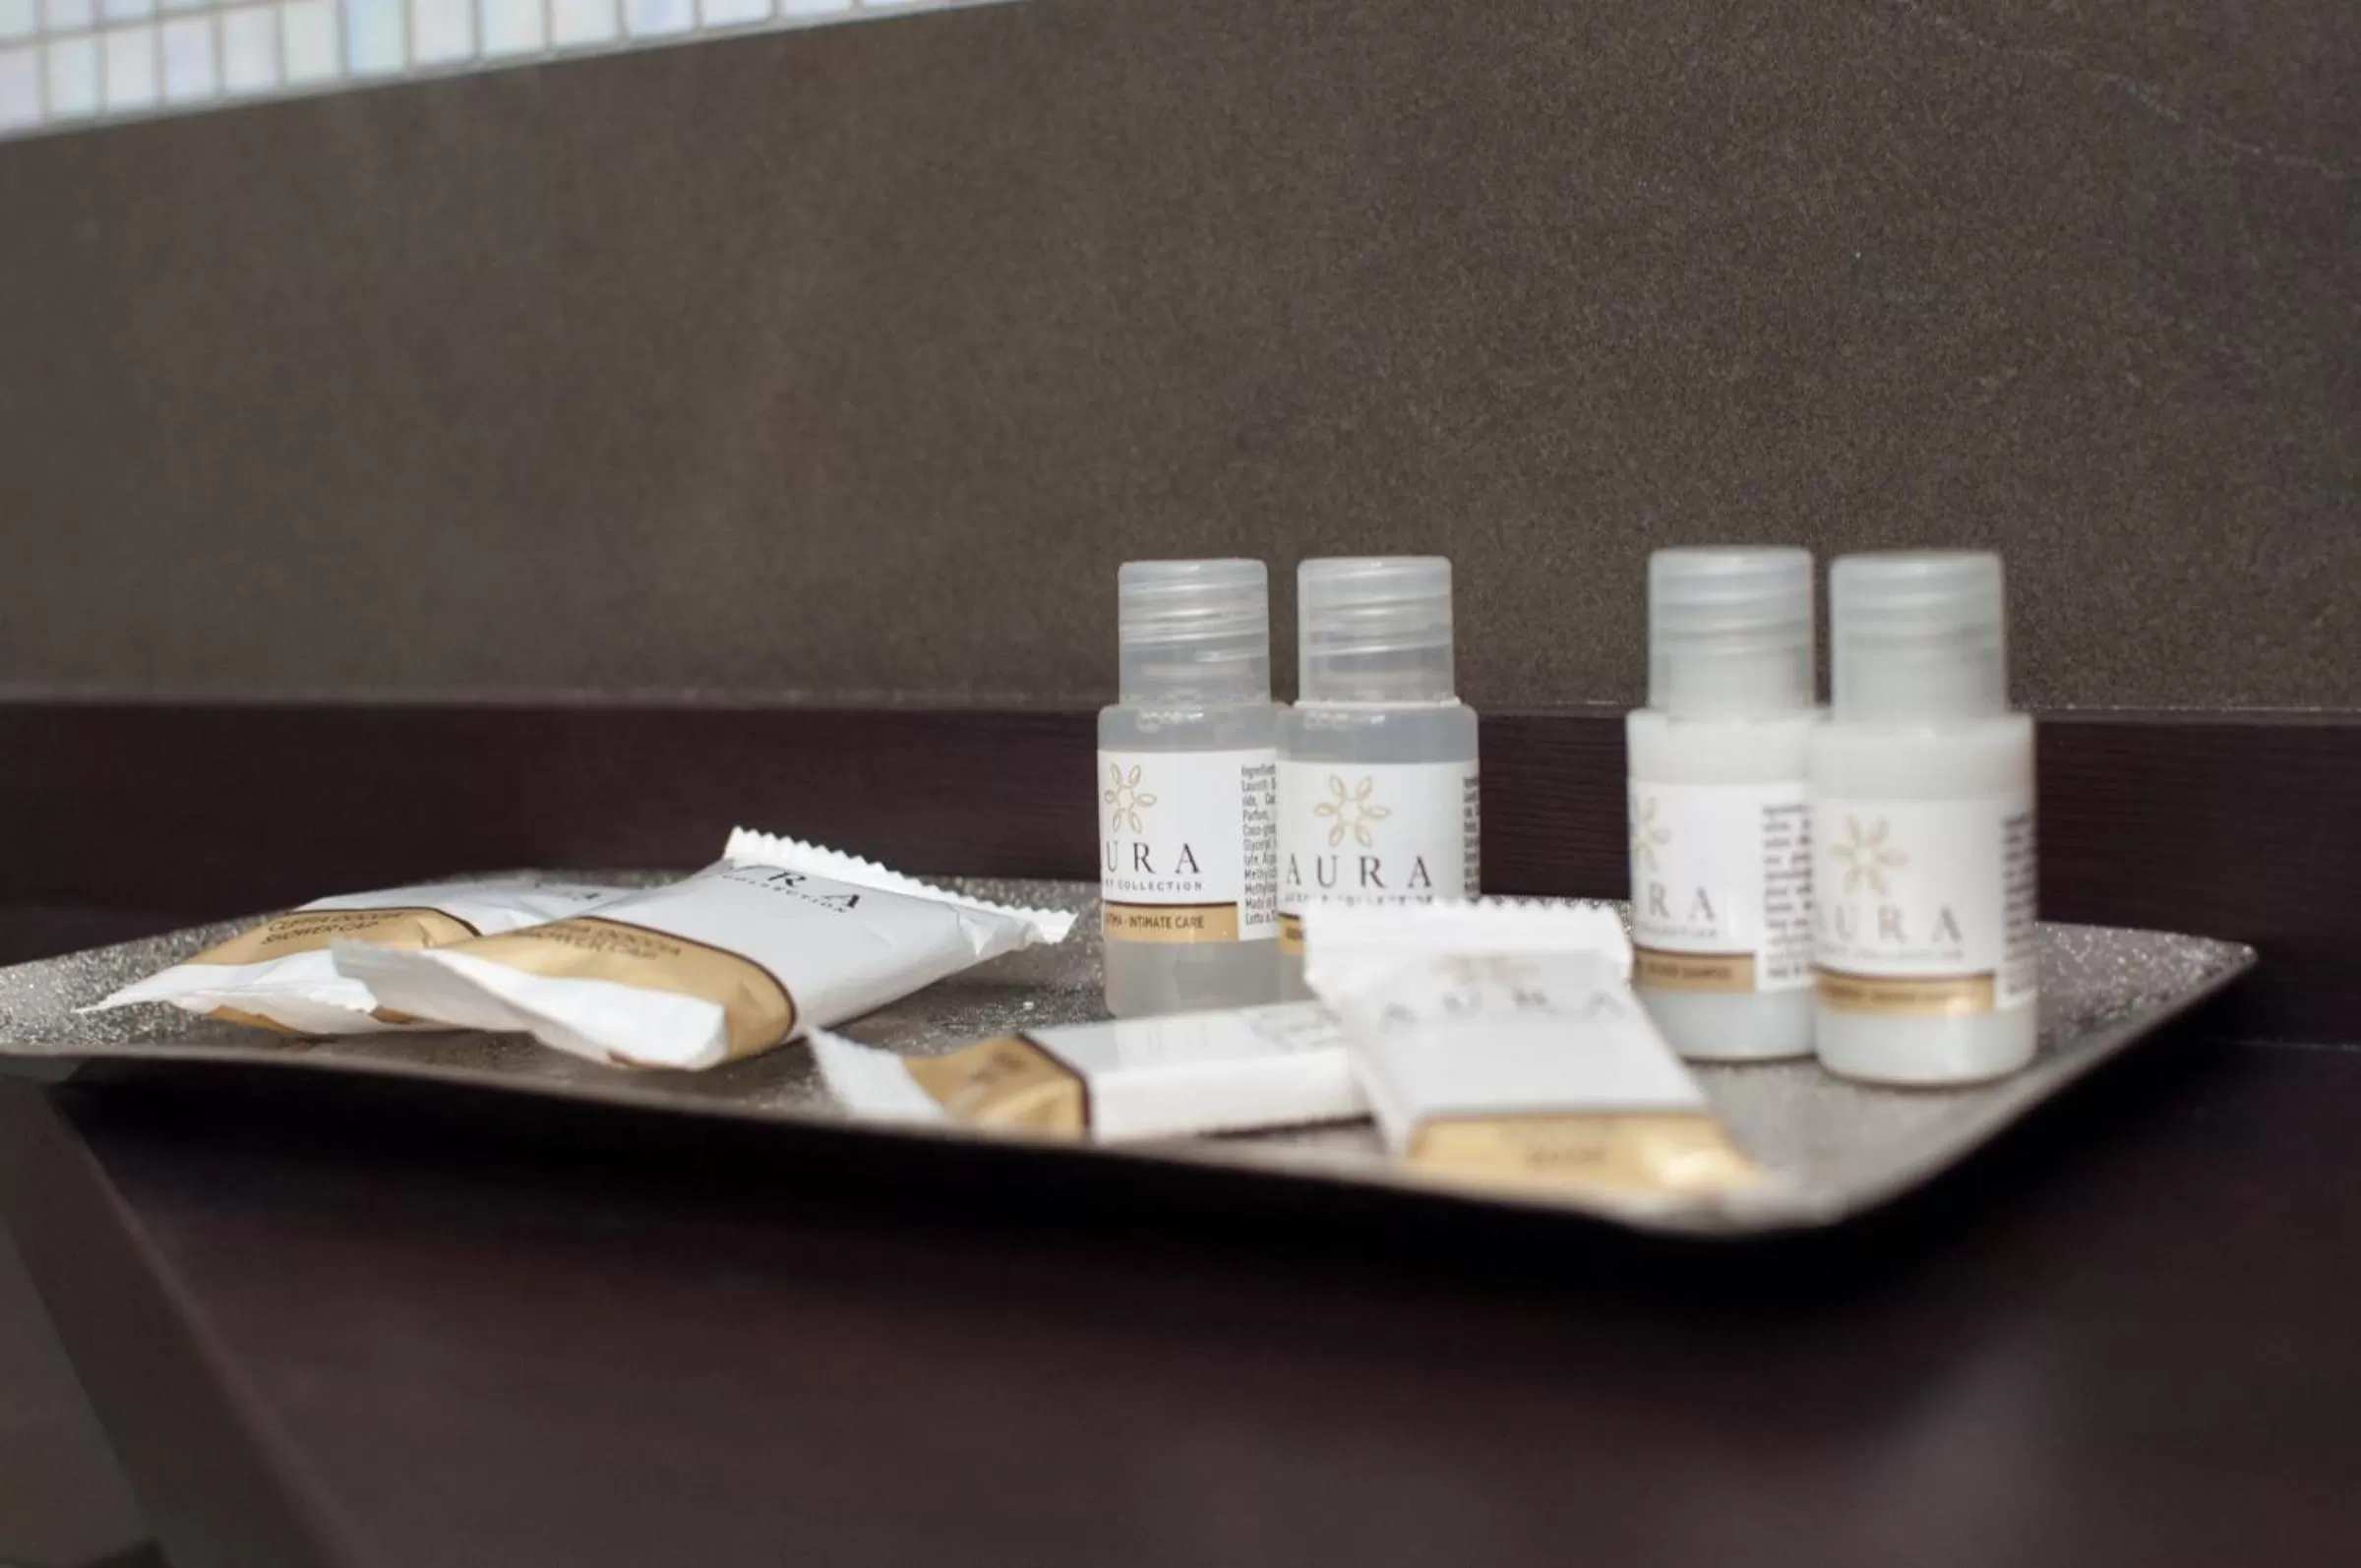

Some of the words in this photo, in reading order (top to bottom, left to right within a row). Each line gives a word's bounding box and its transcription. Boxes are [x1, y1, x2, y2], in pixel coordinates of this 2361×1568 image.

[1106, 842, 1199, 874] URA
[1286, 853, 1432, 888] AURA
[1118, 879, 1202, 892] COLLECTION
[1648, 881, 1716, 921] RA
[1129, 915, 1173, 930] INTIMATE
[1176, 916, 1204, 930] CARE
[1818, 902, 1963, 942] URA
